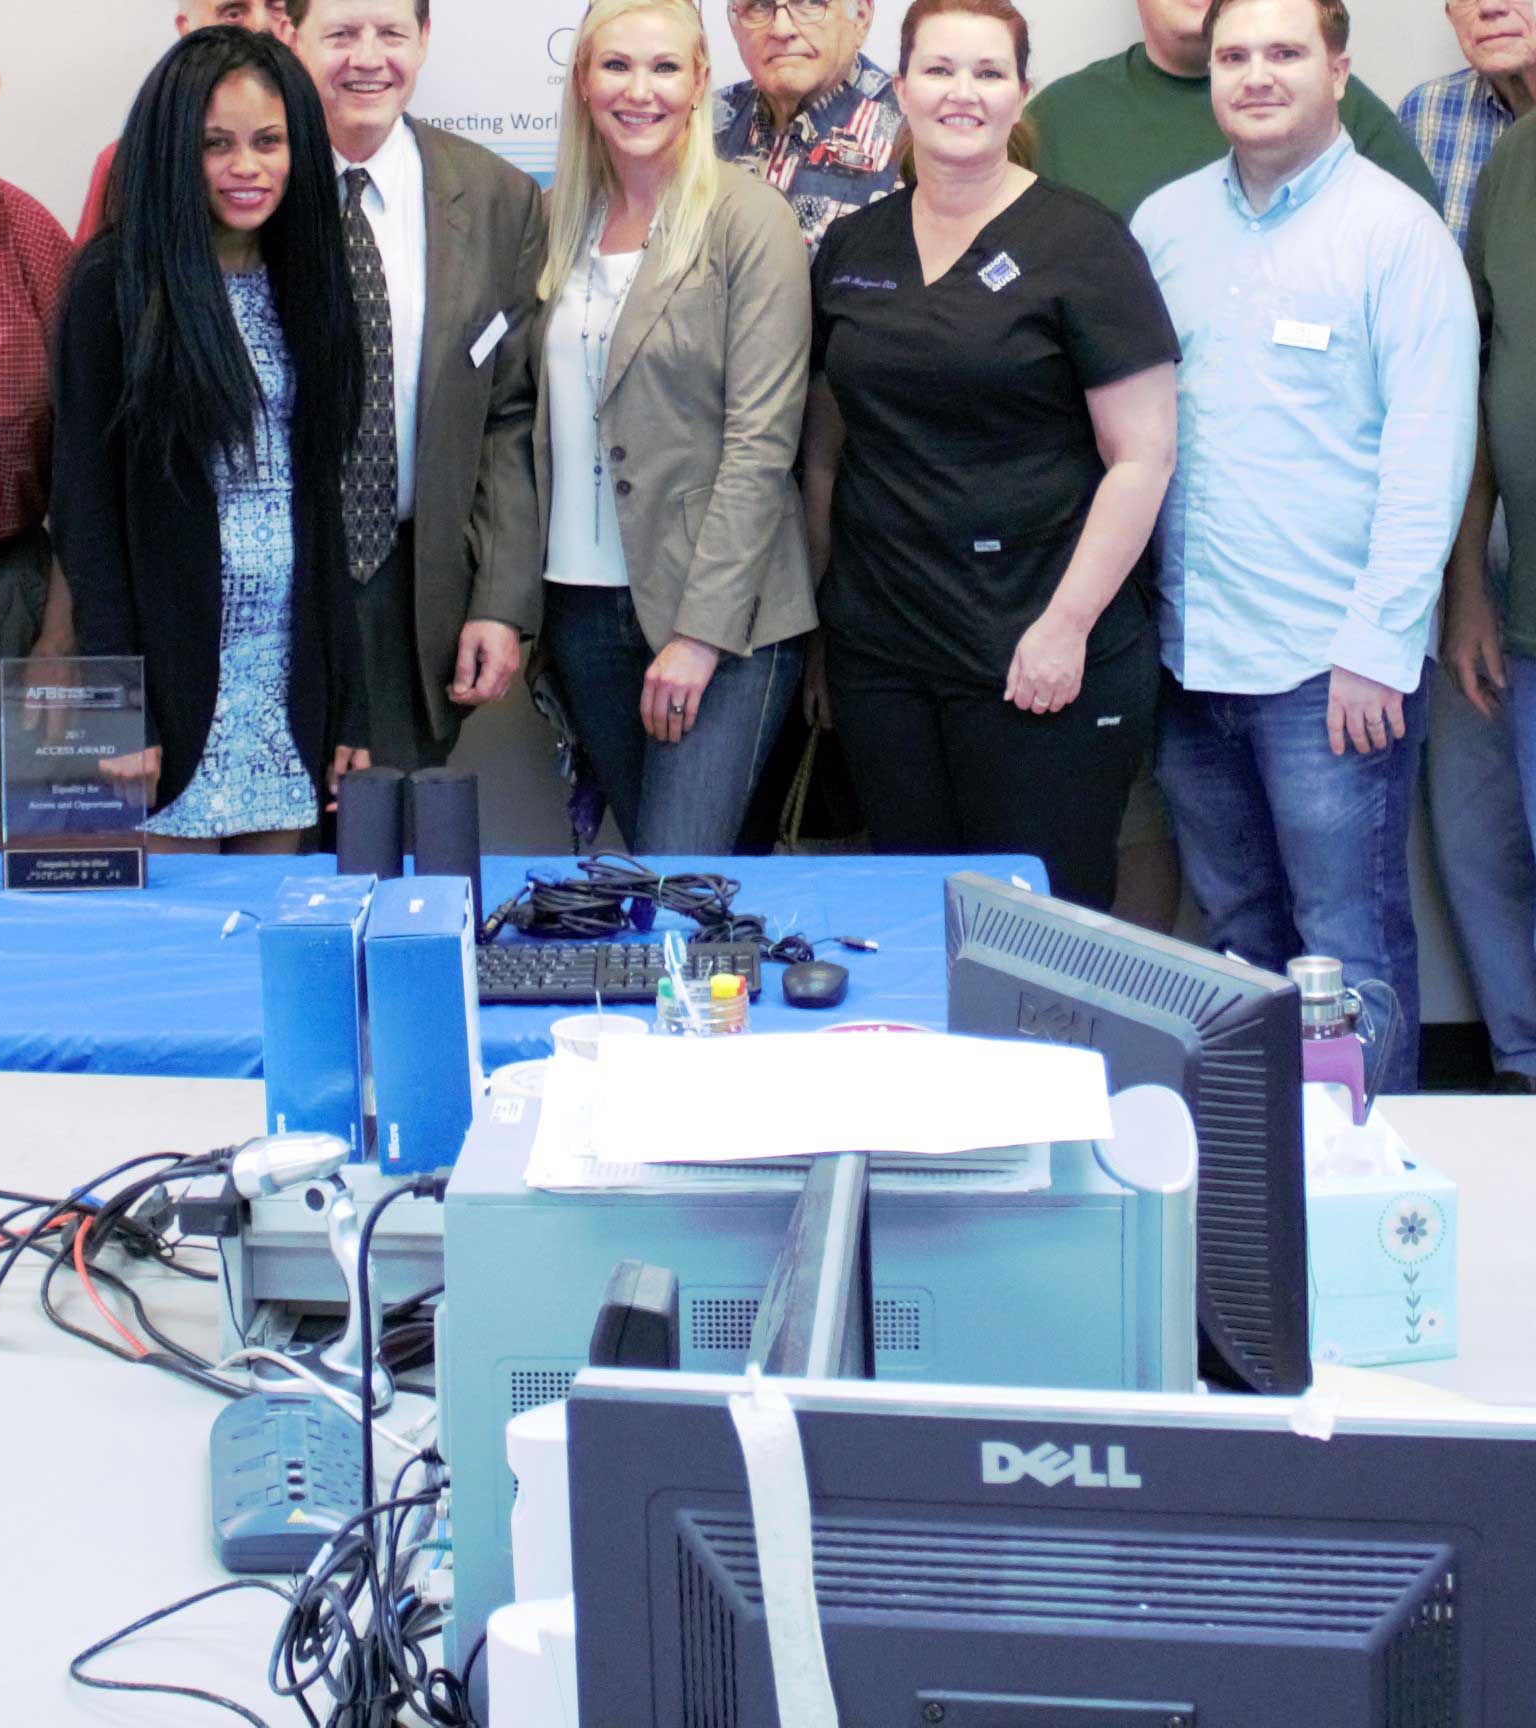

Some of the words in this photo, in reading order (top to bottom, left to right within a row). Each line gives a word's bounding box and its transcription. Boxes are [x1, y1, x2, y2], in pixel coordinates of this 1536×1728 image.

[511, 112, 562, 130] Worl
[35, 746, 74, 756] ACCESS
[77, 745, 115, 756] AWARD
[981, 1441, 1142, 1489] DELL
